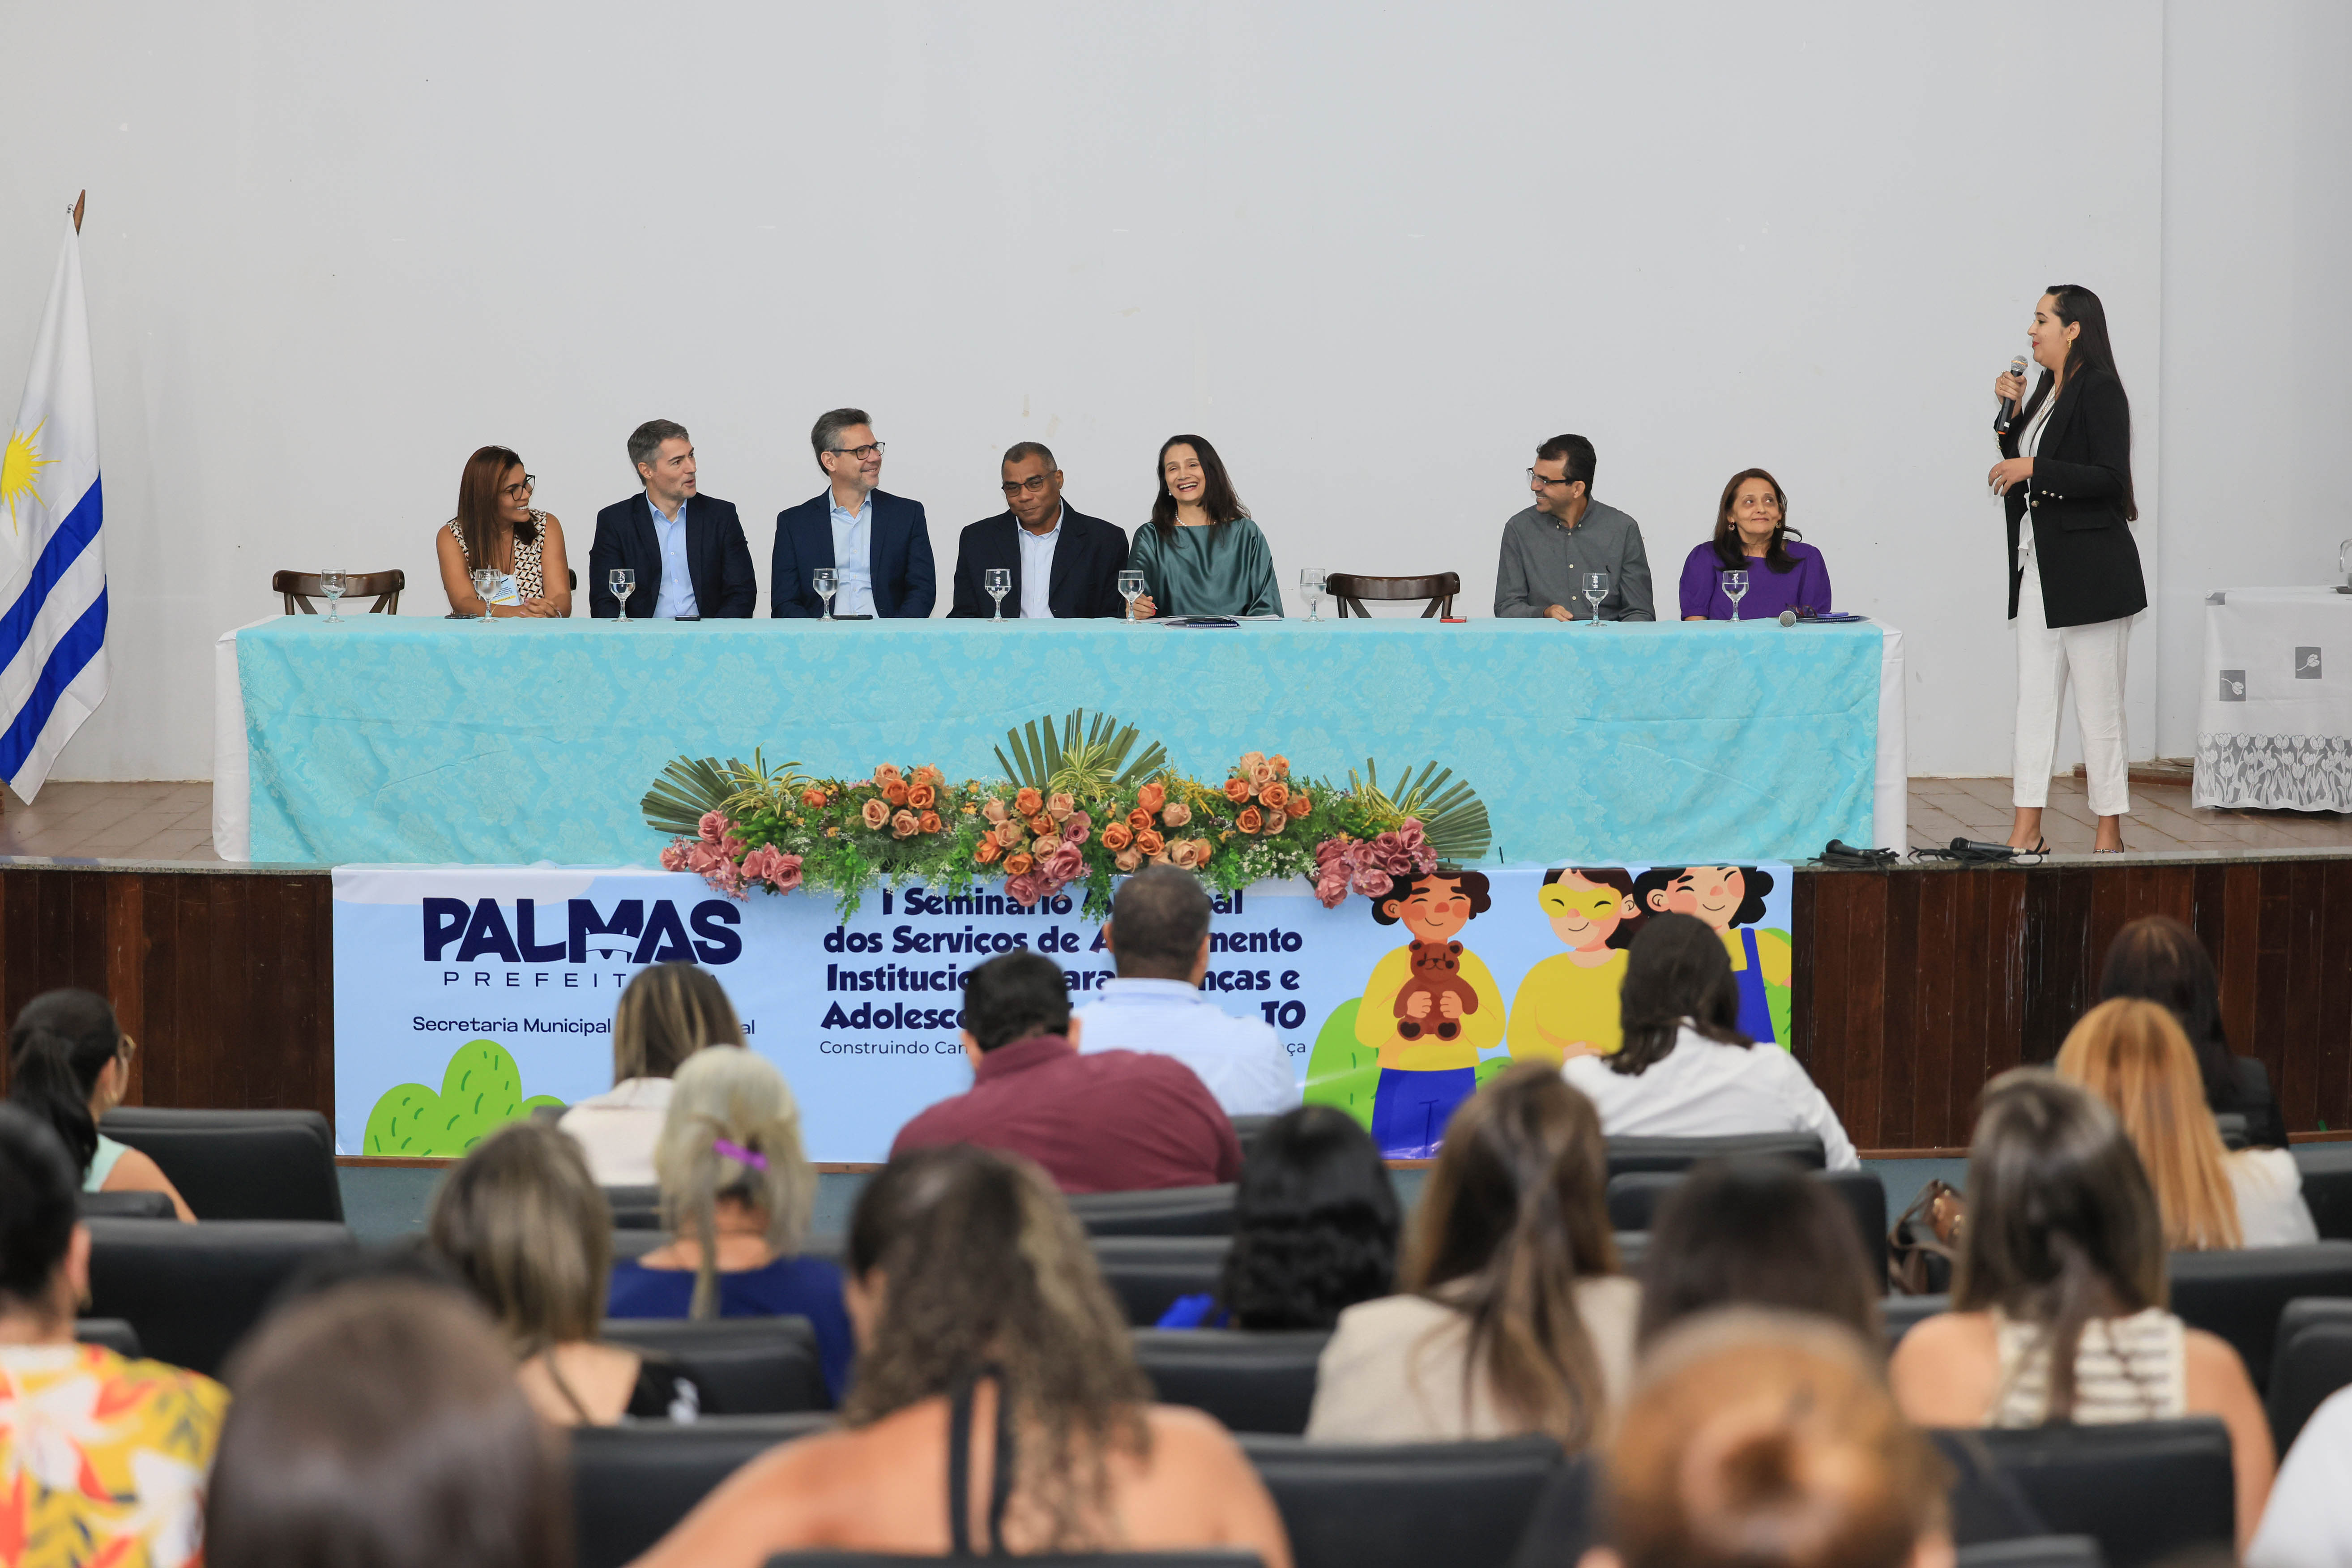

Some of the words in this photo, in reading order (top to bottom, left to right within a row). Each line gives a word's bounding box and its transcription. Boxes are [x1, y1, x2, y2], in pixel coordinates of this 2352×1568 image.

[423, 897, 742, 965] PALMAS
[824, 925, 883, 953] dos
[892, 925, 1029, 956] Serviços
[1037, 925, 1080, 953] de
[444, 971, 626, 988] PREFEIT
[1063, 970, 1116, 991] ara
[1280, 970, 1300, 990] e
[1261, 1000, 1306, 1030] TO
[413, 1016, 518, 1032] Secretaria
[524, 1018, 611, 1037] Municipal
[820, 1040, 929, 1054] Construindo
